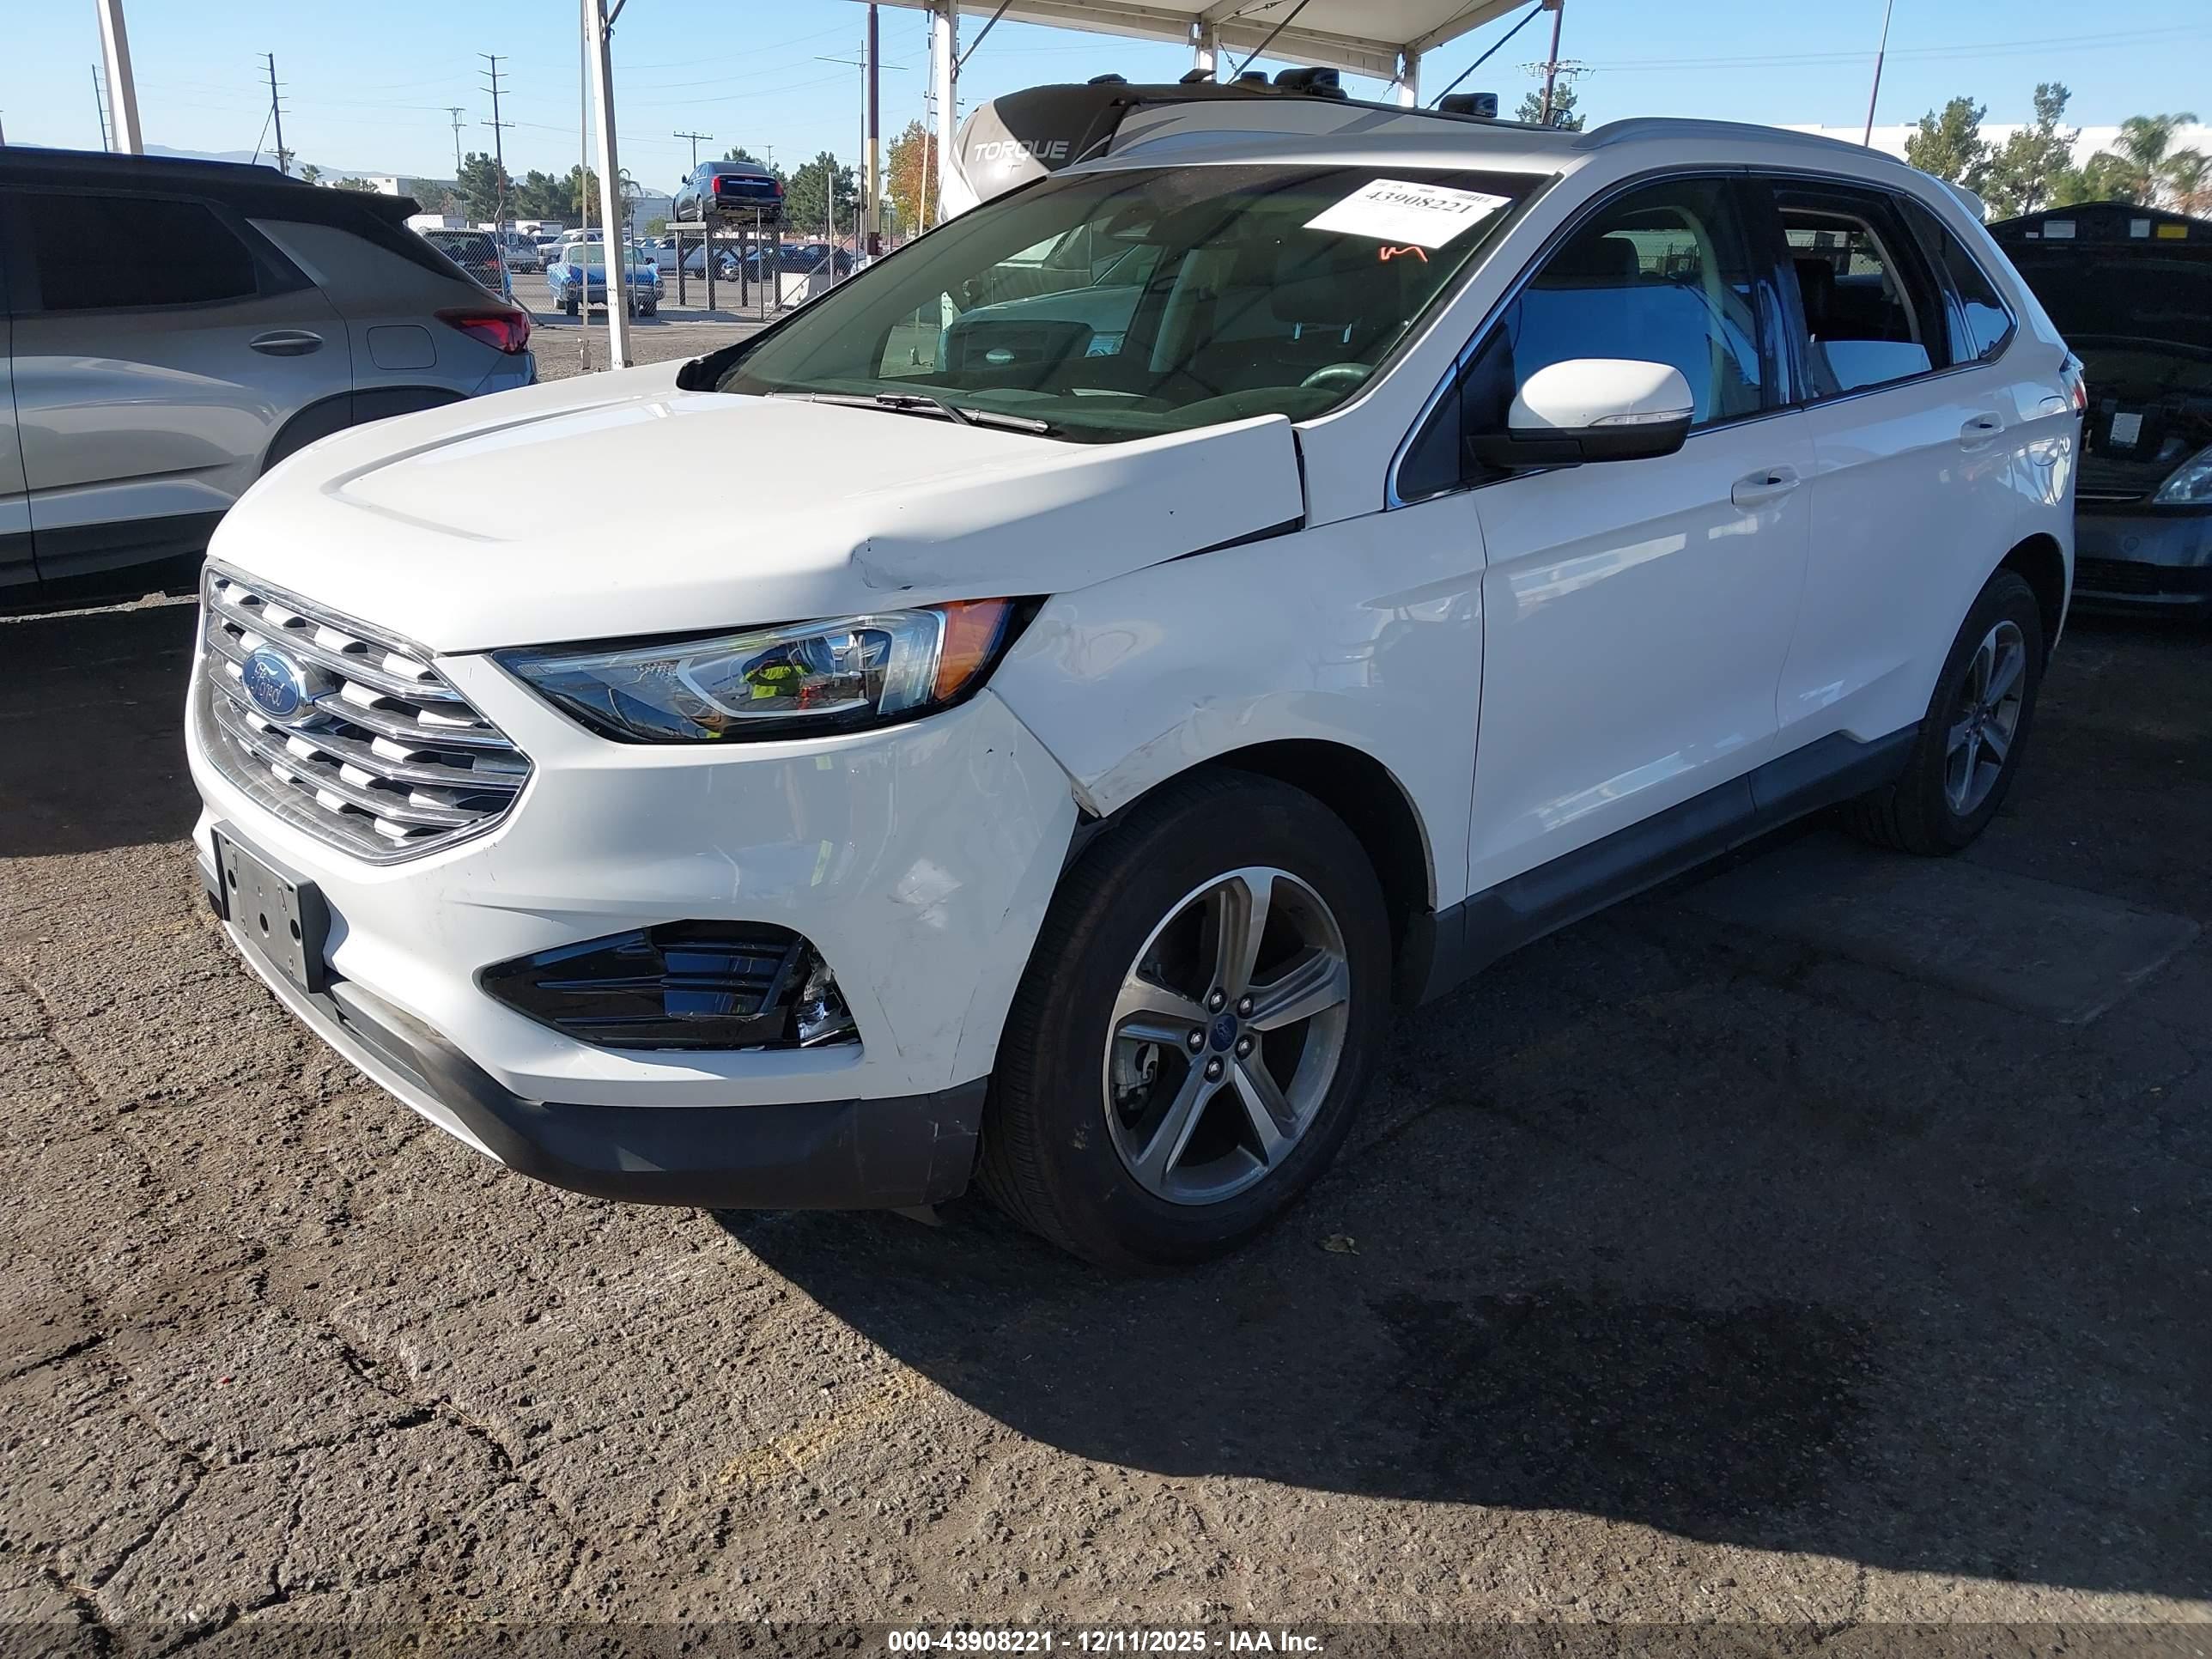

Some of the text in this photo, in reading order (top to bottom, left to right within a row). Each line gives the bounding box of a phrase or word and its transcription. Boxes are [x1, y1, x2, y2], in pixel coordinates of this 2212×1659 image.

[974, 139, 1070, 161] TORQUE
[1365, 191, 1474, 214] 43908221
[250, 661, 285, 708] Ford
